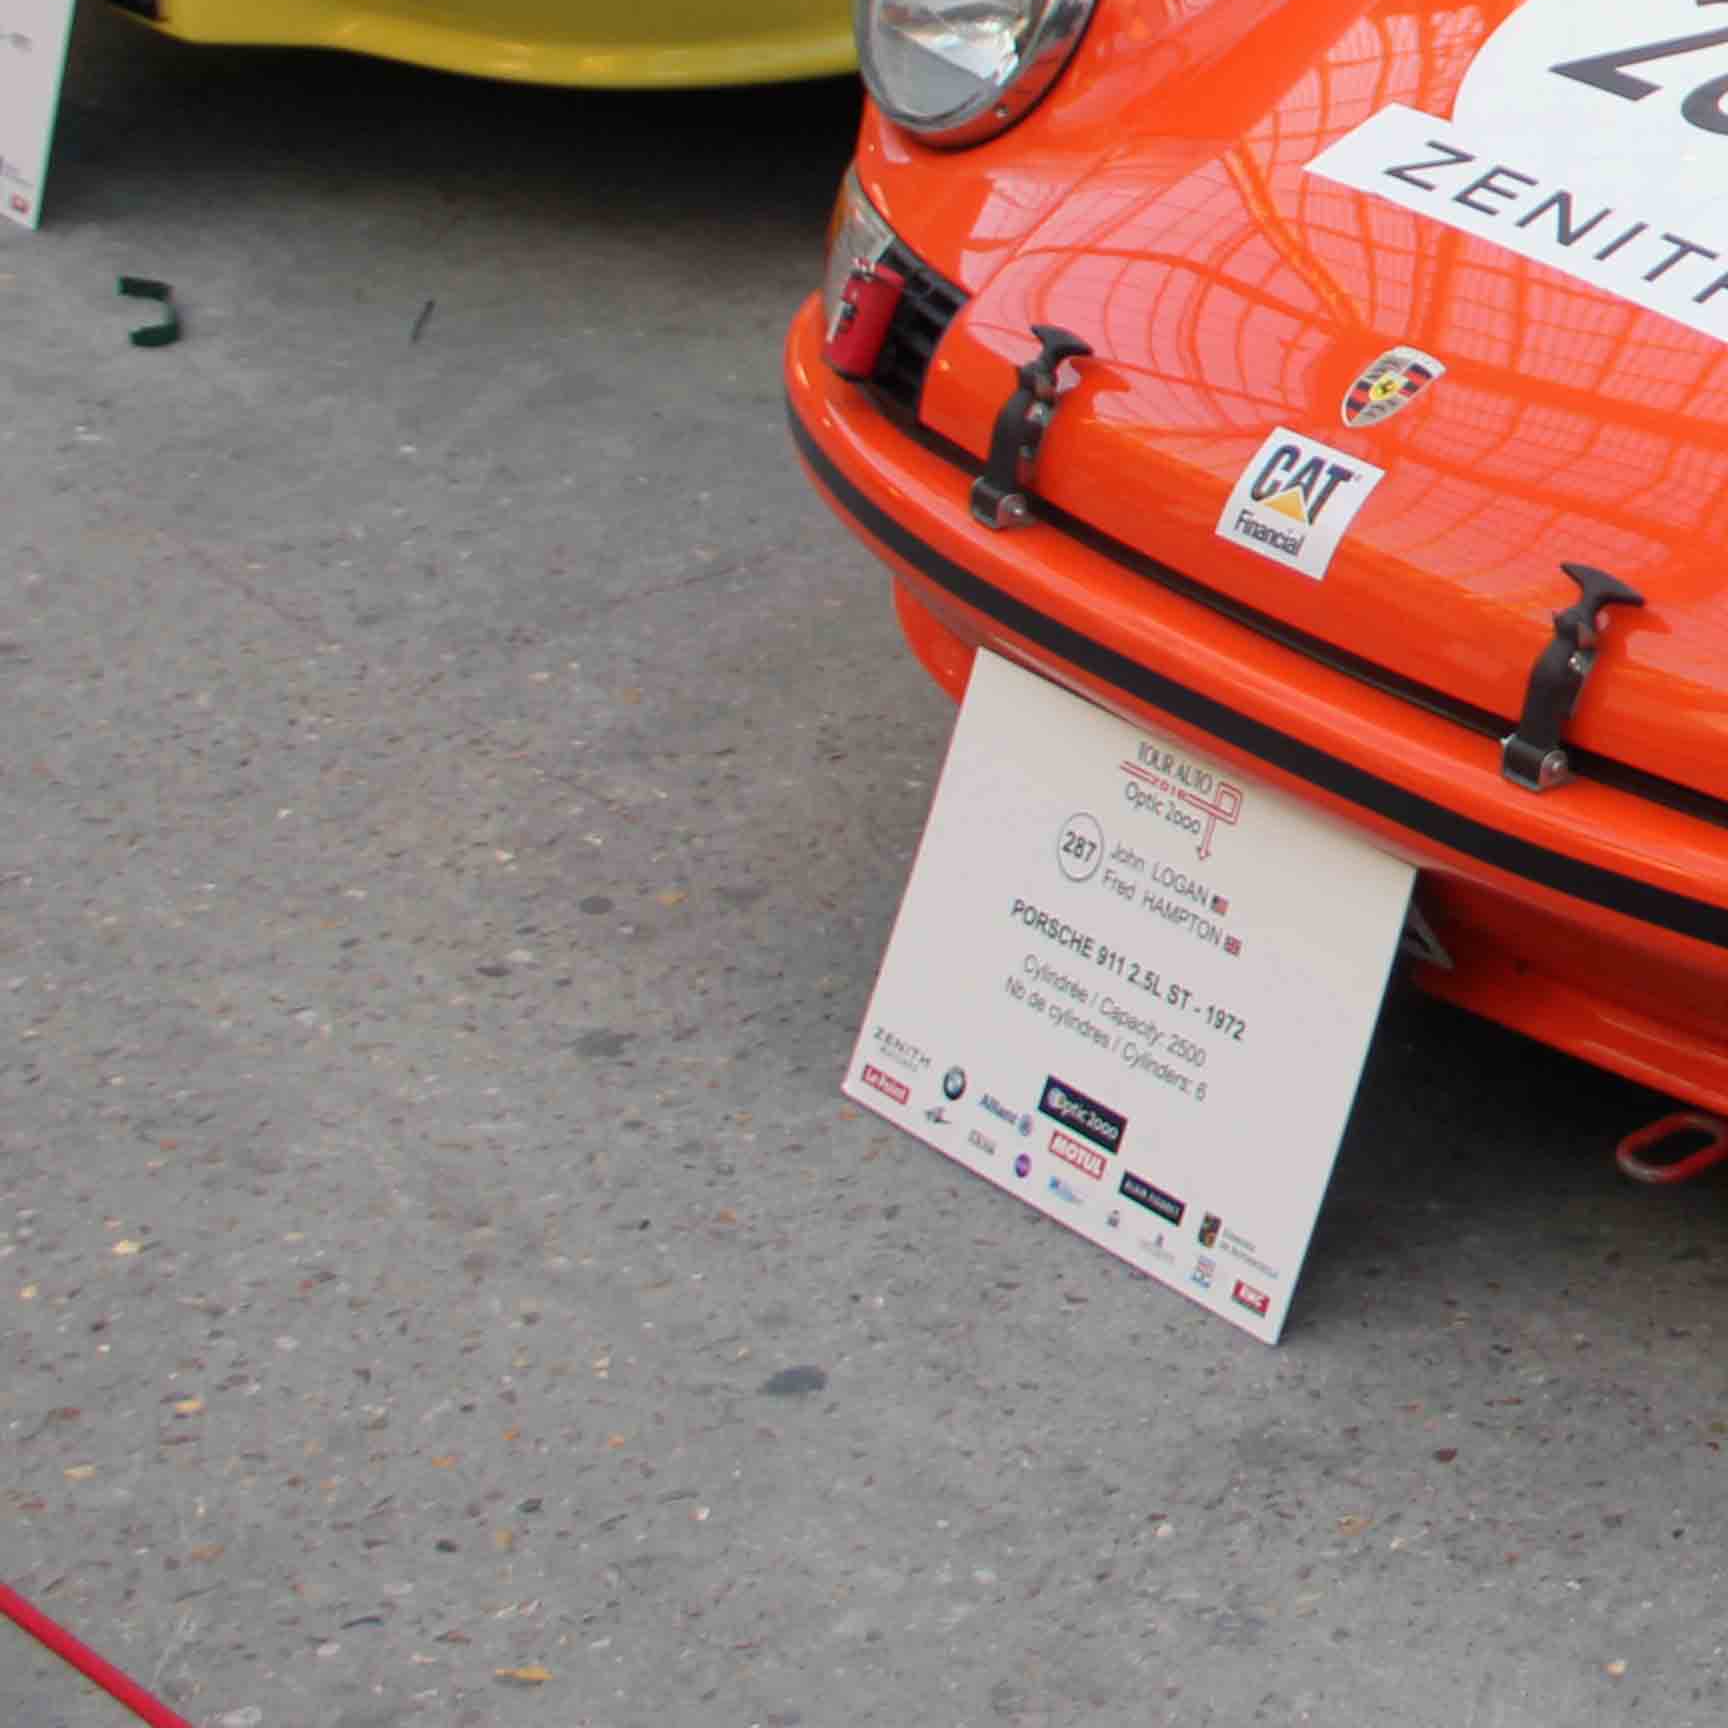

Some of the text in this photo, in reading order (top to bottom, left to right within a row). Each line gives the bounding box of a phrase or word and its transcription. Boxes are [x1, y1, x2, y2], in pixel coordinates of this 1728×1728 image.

[1250, 445, 1353, 525] CAT
[1233, 508, 1305, 557] Financial
[1124, 780, 1202, 834] Optic 2000
[1062, 830, 1097, 863] 287
[1110, 840, 1209, 905] John LOGAN
[1103, 868, 1223, 946] Fred HAMPTON
[1010, 898, 1095, 960] PORSCHE
[1096, 944, 1126, 976] 911
[1127, 962, 1161, 998] 2.5L
[1166, 983, 1193, 1011] ST
[1204, 1004, 1247, 1041] 1972
[1166, 1033, 1207, 1068] 2500
[1052, 1135, 1102, 1175] MOTUL
